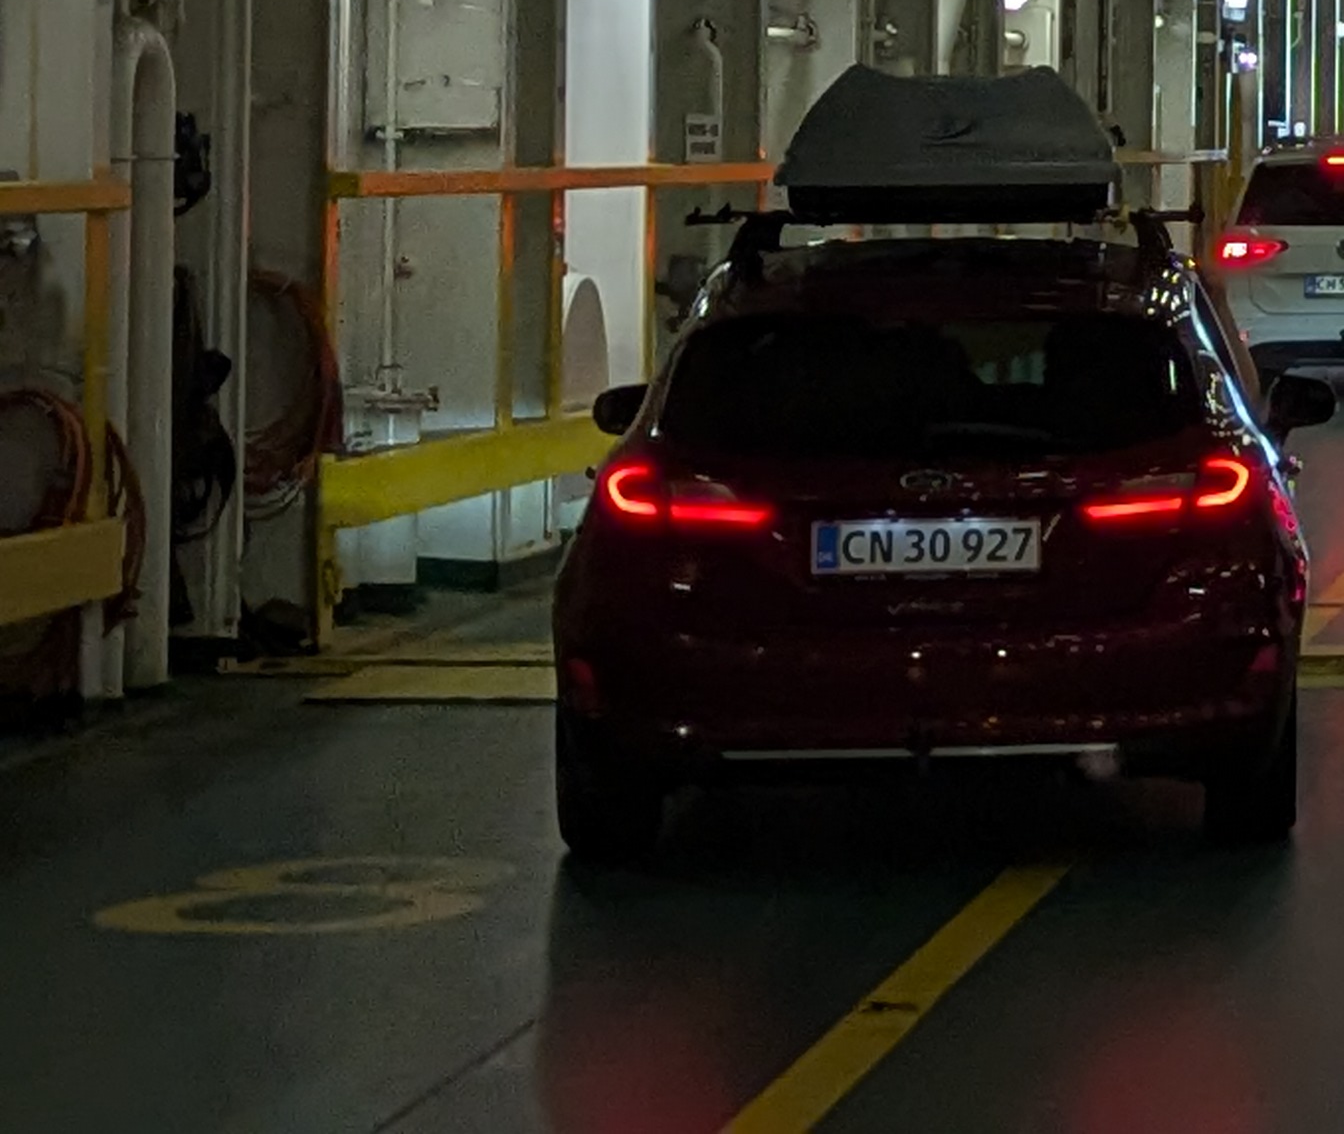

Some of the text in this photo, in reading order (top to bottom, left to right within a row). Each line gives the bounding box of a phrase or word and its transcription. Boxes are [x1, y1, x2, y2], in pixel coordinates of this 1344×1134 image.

[842, 527, 1033, 565] CN 30 927
[94, 855, 517, 935] 8
